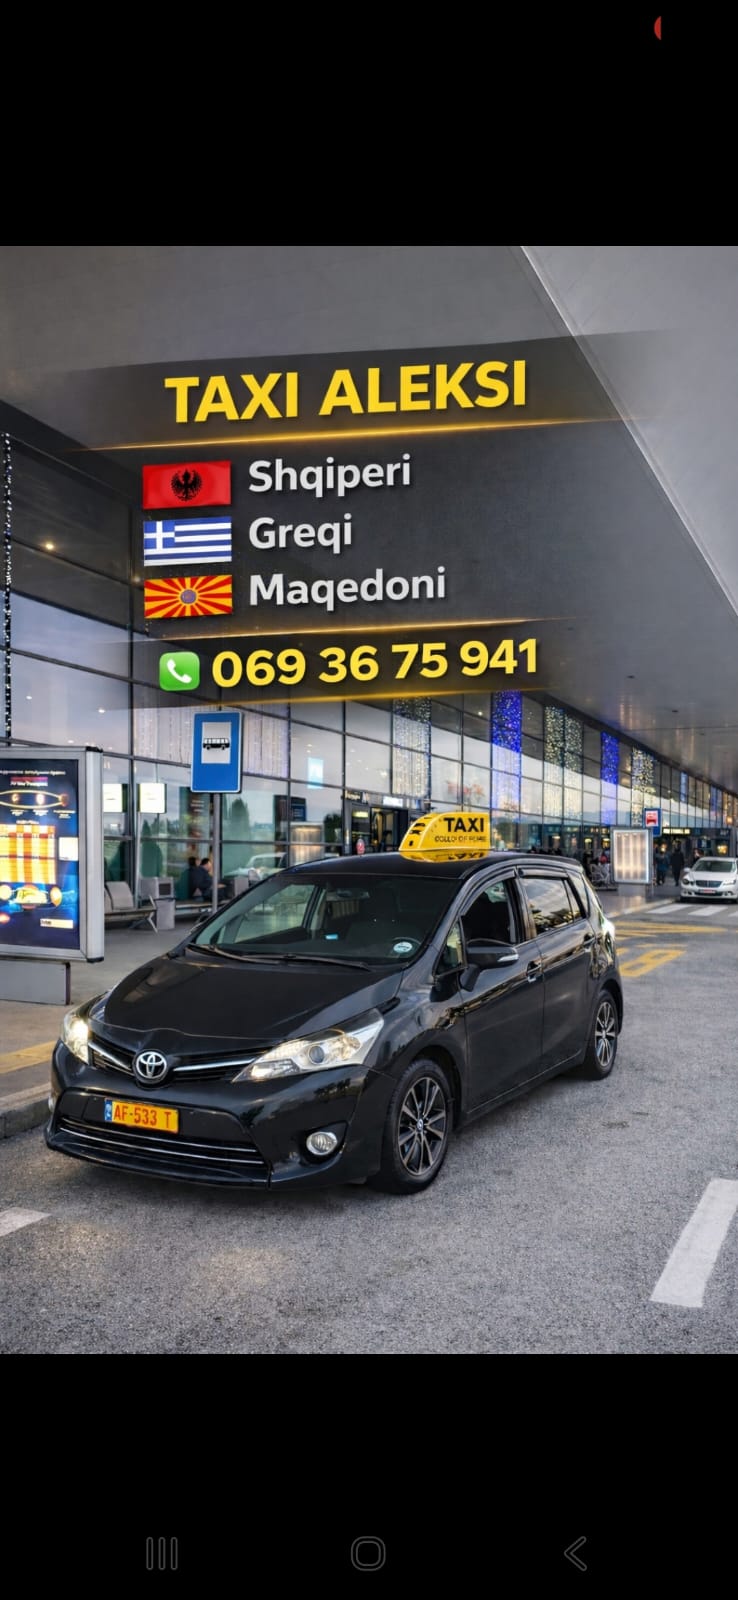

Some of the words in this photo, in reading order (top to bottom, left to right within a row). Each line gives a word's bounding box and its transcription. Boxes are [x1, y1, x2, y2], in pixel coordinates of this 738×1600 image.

[443, 817, 484, 833] TAXI
[114, 1104, 157, 1126] AF-533
[164, 1111, 172, 1129] T
